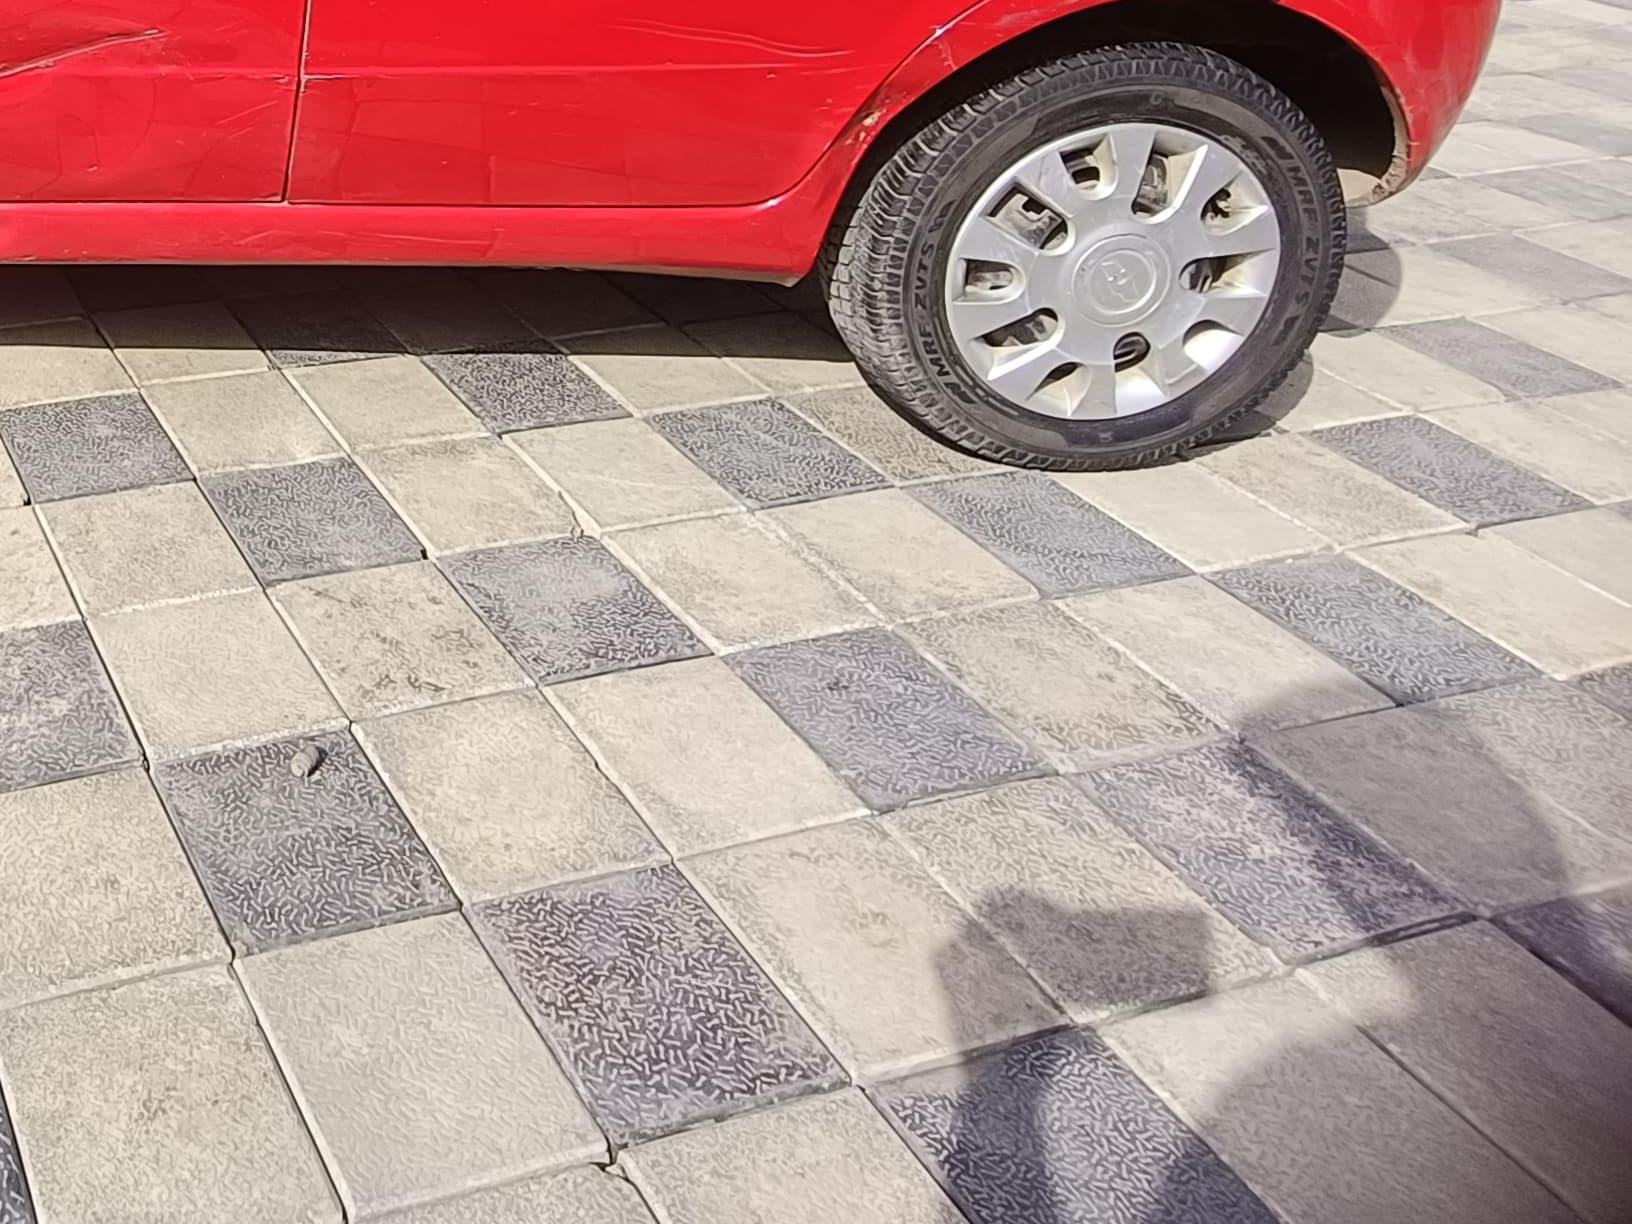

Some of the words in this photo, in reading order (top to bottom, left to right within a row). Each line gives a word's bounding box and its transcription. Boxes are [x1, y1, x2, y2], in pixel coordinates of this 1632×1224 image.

[1286, 166, 1319, 223] MRF
[914, 240, 935, 309] ZVTS
[1294, 236, 1320, 306] ZVTS
[919, 325, 951, 377] MRF
